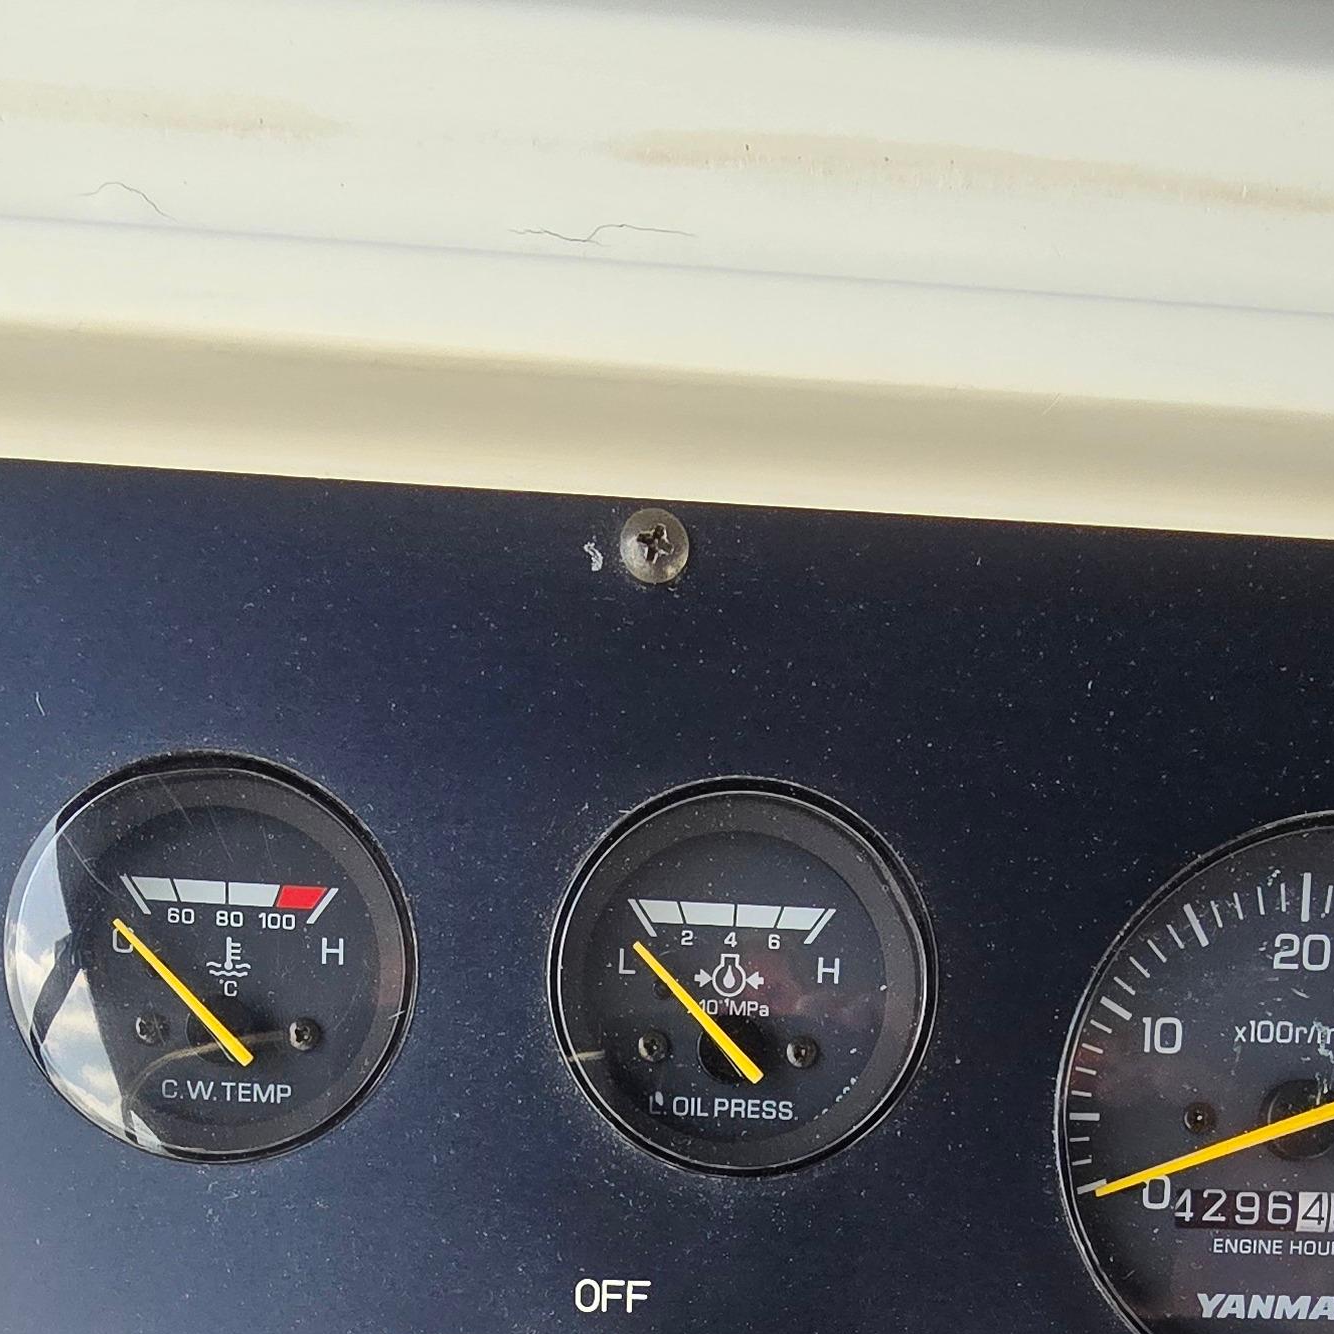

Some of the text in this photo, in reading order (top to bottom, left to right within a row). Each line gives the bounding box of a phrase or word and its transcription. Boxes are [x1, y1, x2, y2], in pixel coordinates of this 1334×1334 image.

[167, 907, 296, 930] 60 80 100
[321, 937, 344, 966] H
[680, 930, 781, 950] 2 4 6
[1273, 933, 1331, 972] 20
[619, 948, 636, 975] L
[817, 957, 840, 984] H
[1142, 1016, 1183, 1054] 10
[672, 1096, 709, 1117] OIL
[1142, 1174, 1170, 1210] 0
[1212, 1237, 1283, 1256] ENGINE
[574, 1279, 652, 1314] OFF
